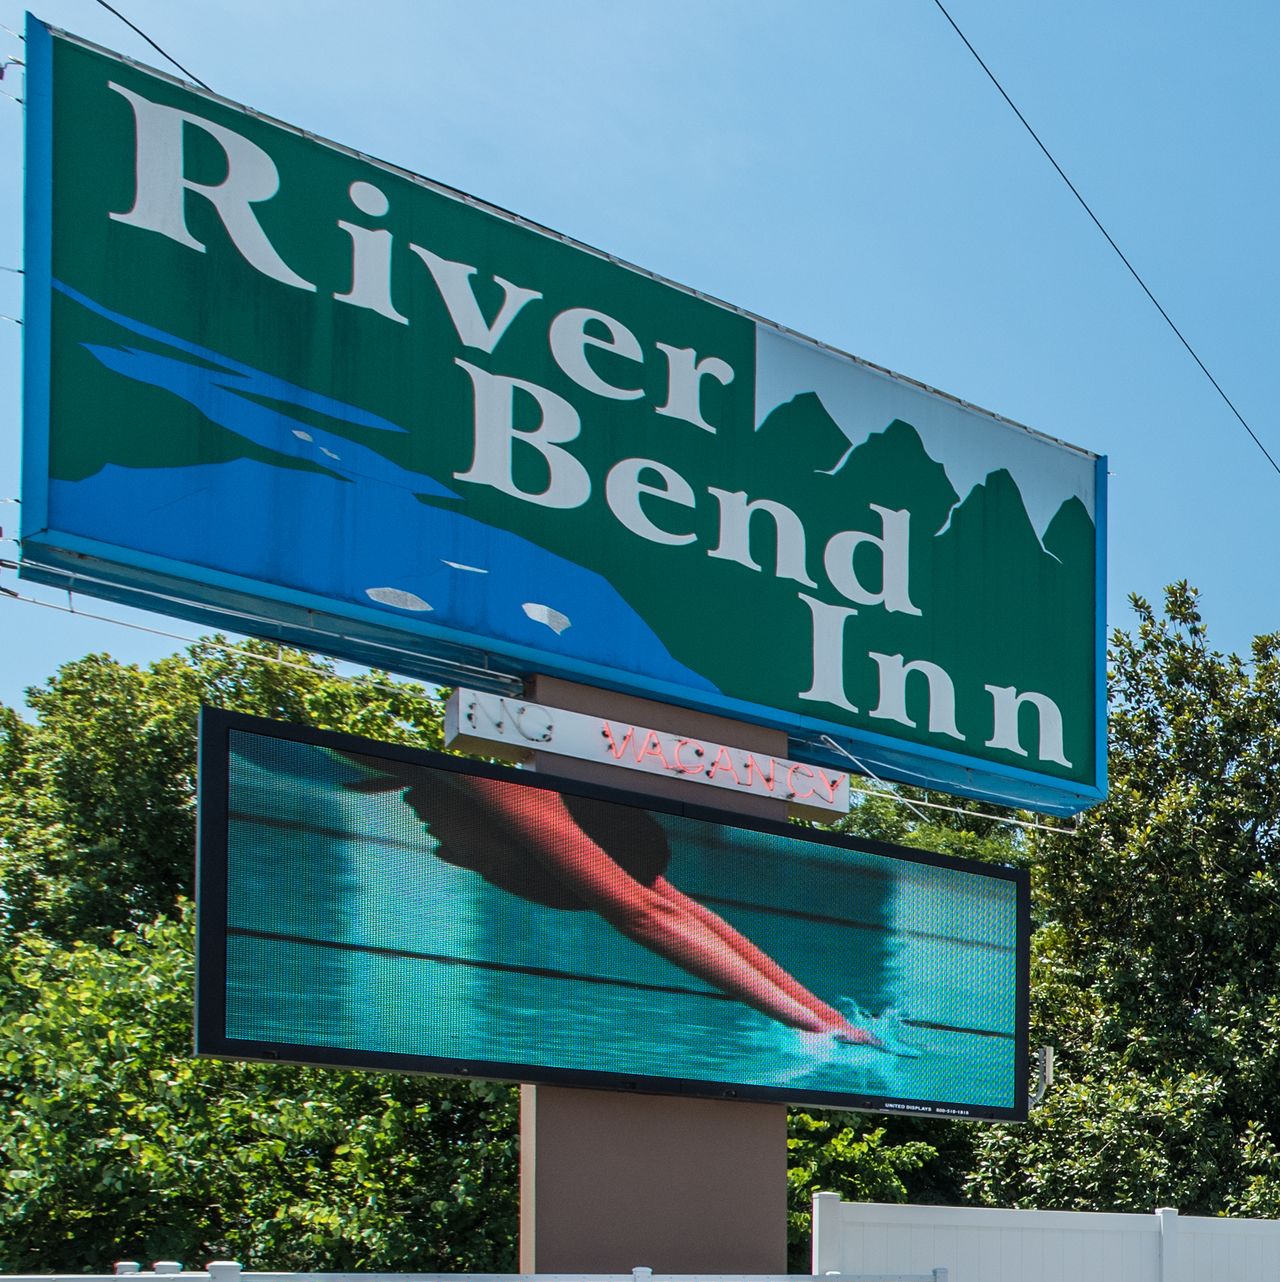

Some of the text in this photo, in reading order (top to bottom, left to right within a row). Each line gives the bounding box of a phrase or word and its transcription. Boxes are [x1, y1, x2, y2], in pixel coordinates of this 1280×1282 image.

[107, 80, 736, 434] River
[453, 357, 924, 616] Bend
[466, 691, 846, 804] NO VACANCY
[797, 591, 1074, 769] Inn
[906, 1104, 932, 1112] DISPLAYS
